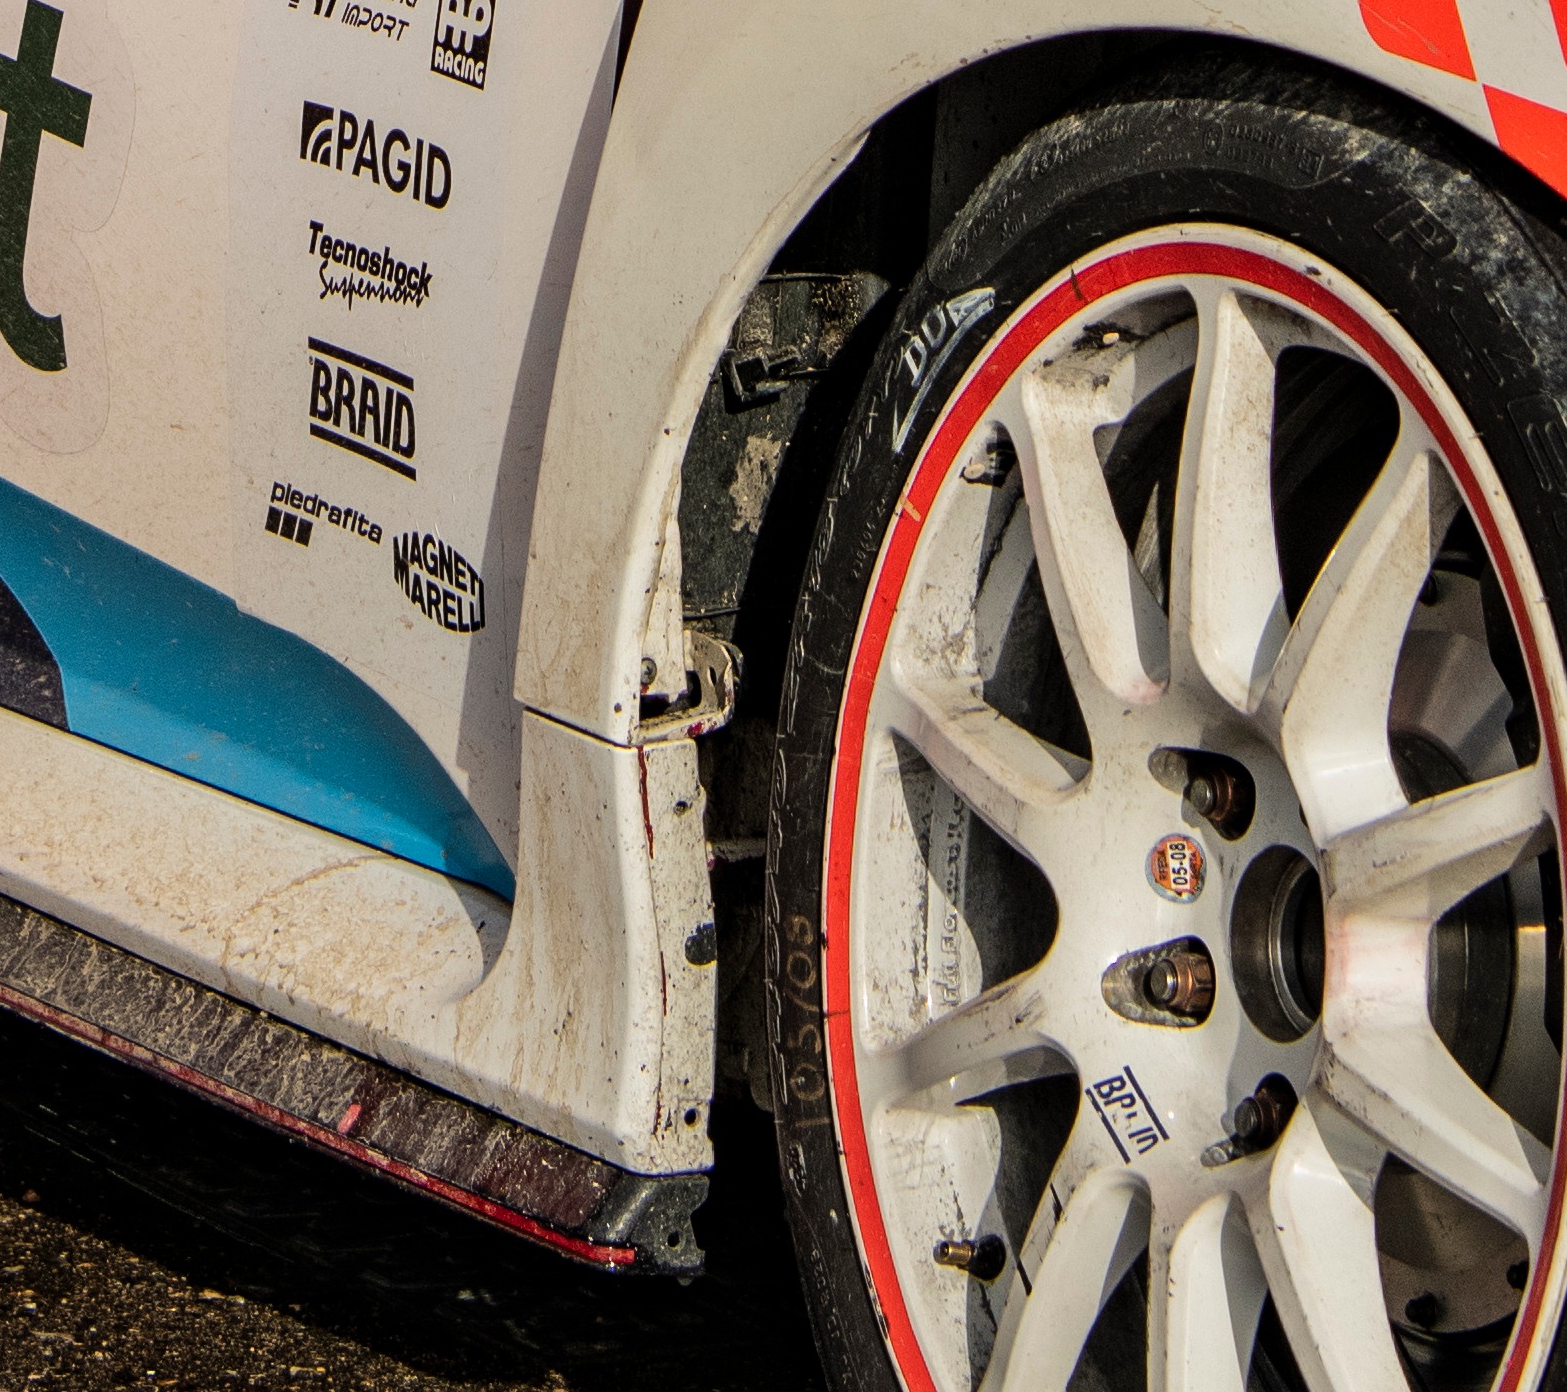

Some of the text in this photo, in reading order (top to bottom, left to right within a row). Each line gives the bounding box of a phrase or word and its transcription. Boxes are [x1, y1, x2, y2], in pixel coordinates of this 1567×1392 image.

[341, 2, 410, 42] IMPORT
[434, 45, 485, 86] RACING
[335, 108, 452, 210] PAGID
[308, 218, 434, 299] Tecnoshock
[318, 259, 425, 312] Suspensions
[309, 357, 416, 459] BRAID
